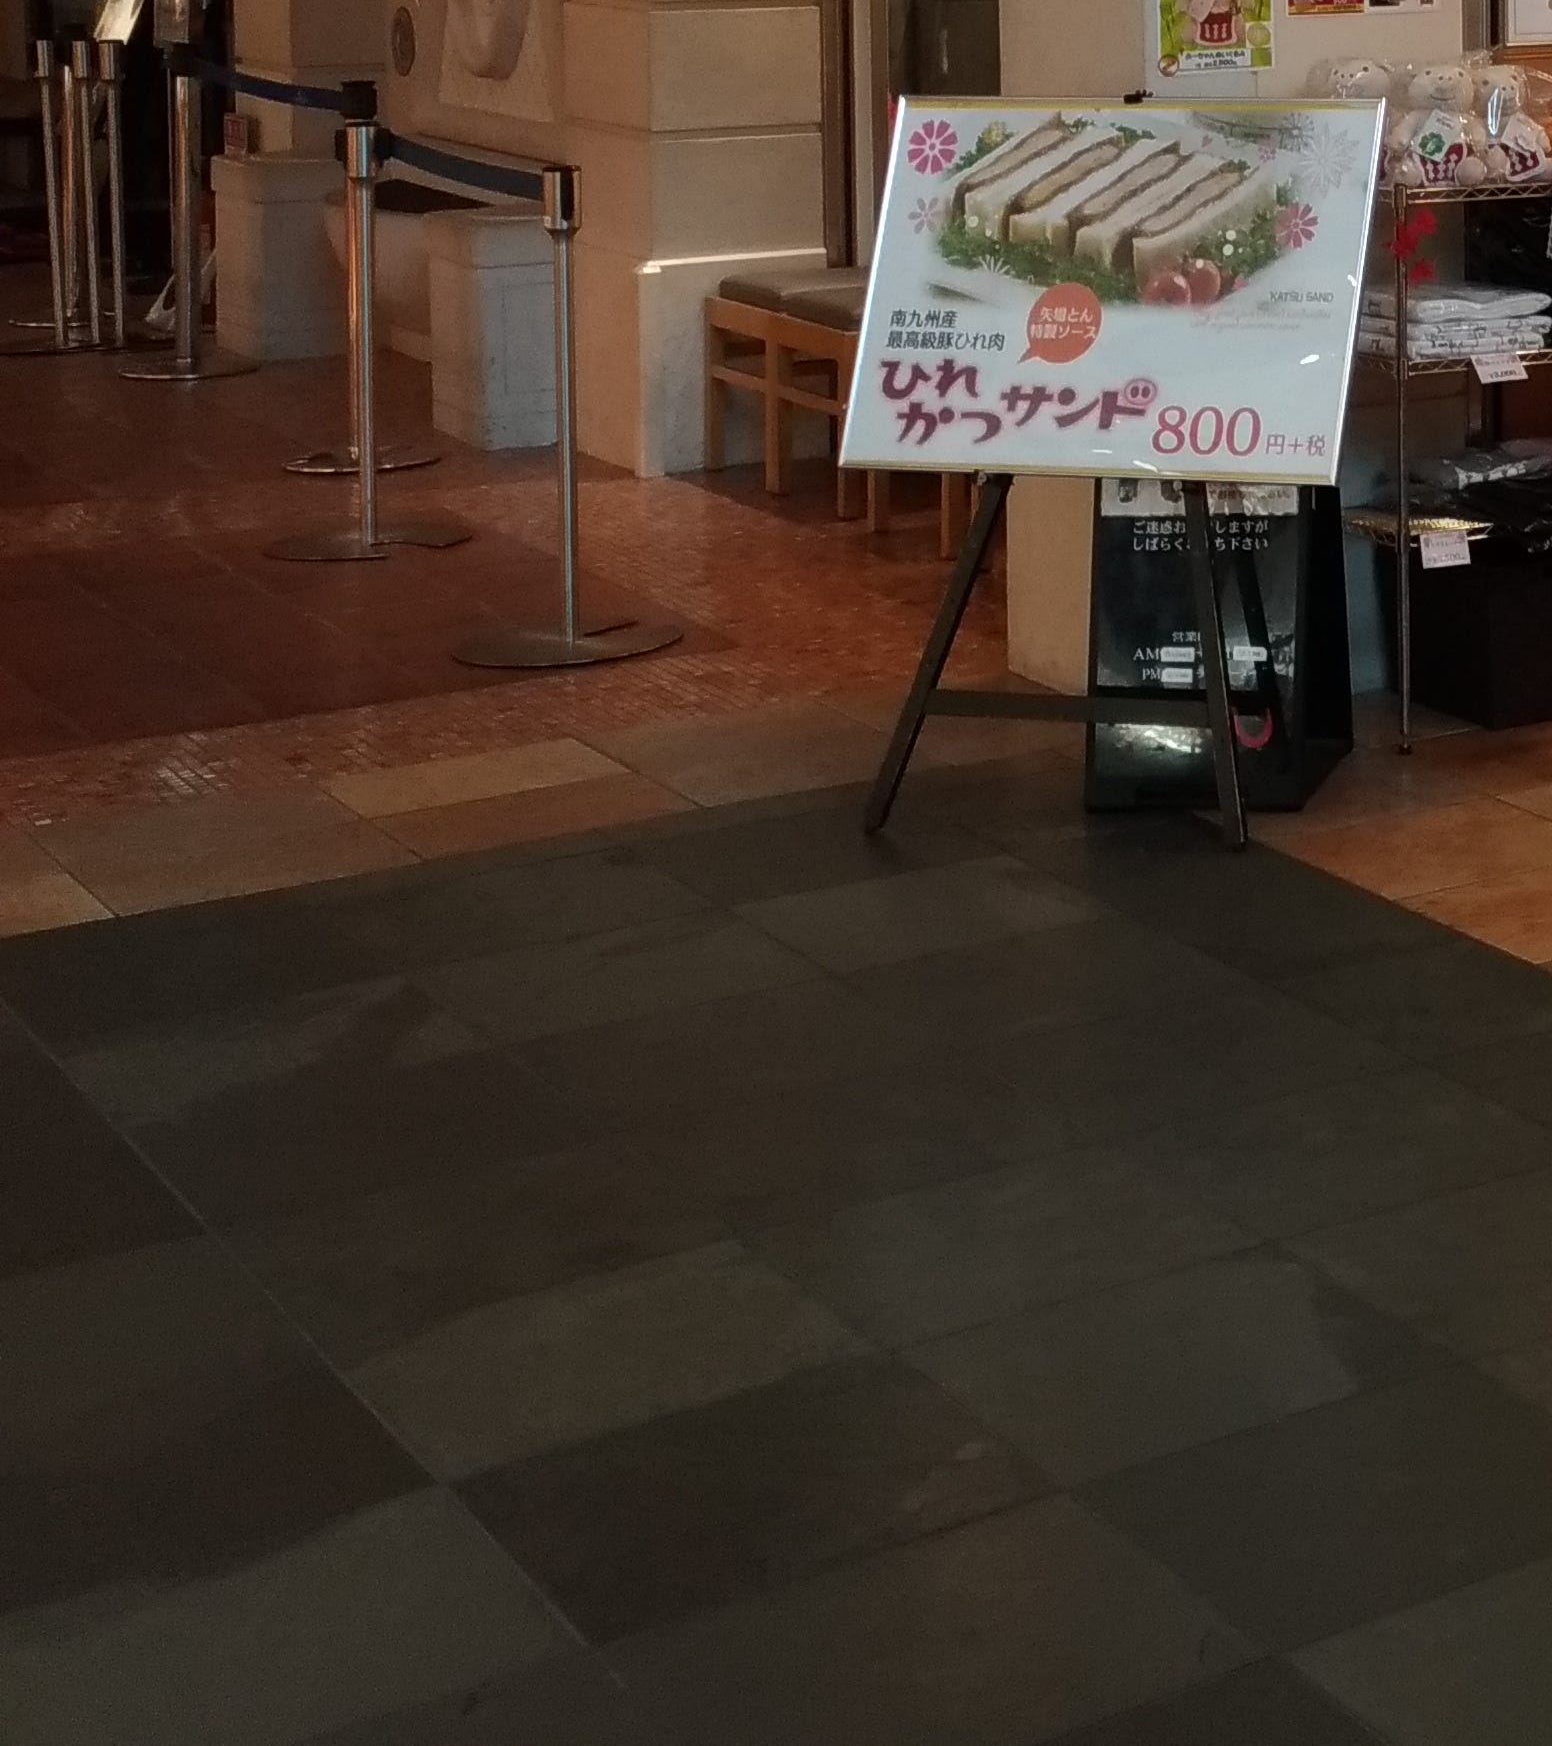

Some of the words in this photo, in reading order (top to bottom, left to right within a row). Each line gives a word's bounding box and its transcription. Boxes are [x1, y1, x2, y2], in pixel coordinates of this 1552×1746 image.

[1270, 290, 1304, 302] KATSU
[1306, 291, 1335, 303] SAND
[889, 309, 958, 328] 南九州産
[1040, 306, 1093, 322] 矢場とん
[1030, 323, 1097, 340] 特製ソース
[886, 331, 1006, 352] 最高級豚ひれ肉
[880, 358, 979, 400] ひれ
[1000, 377, 1157, 431] サンド
[1133, 520, 1269, 535] ご迷惑おしますが
[1133, 537, 1269, 552] しばらくち下さい
